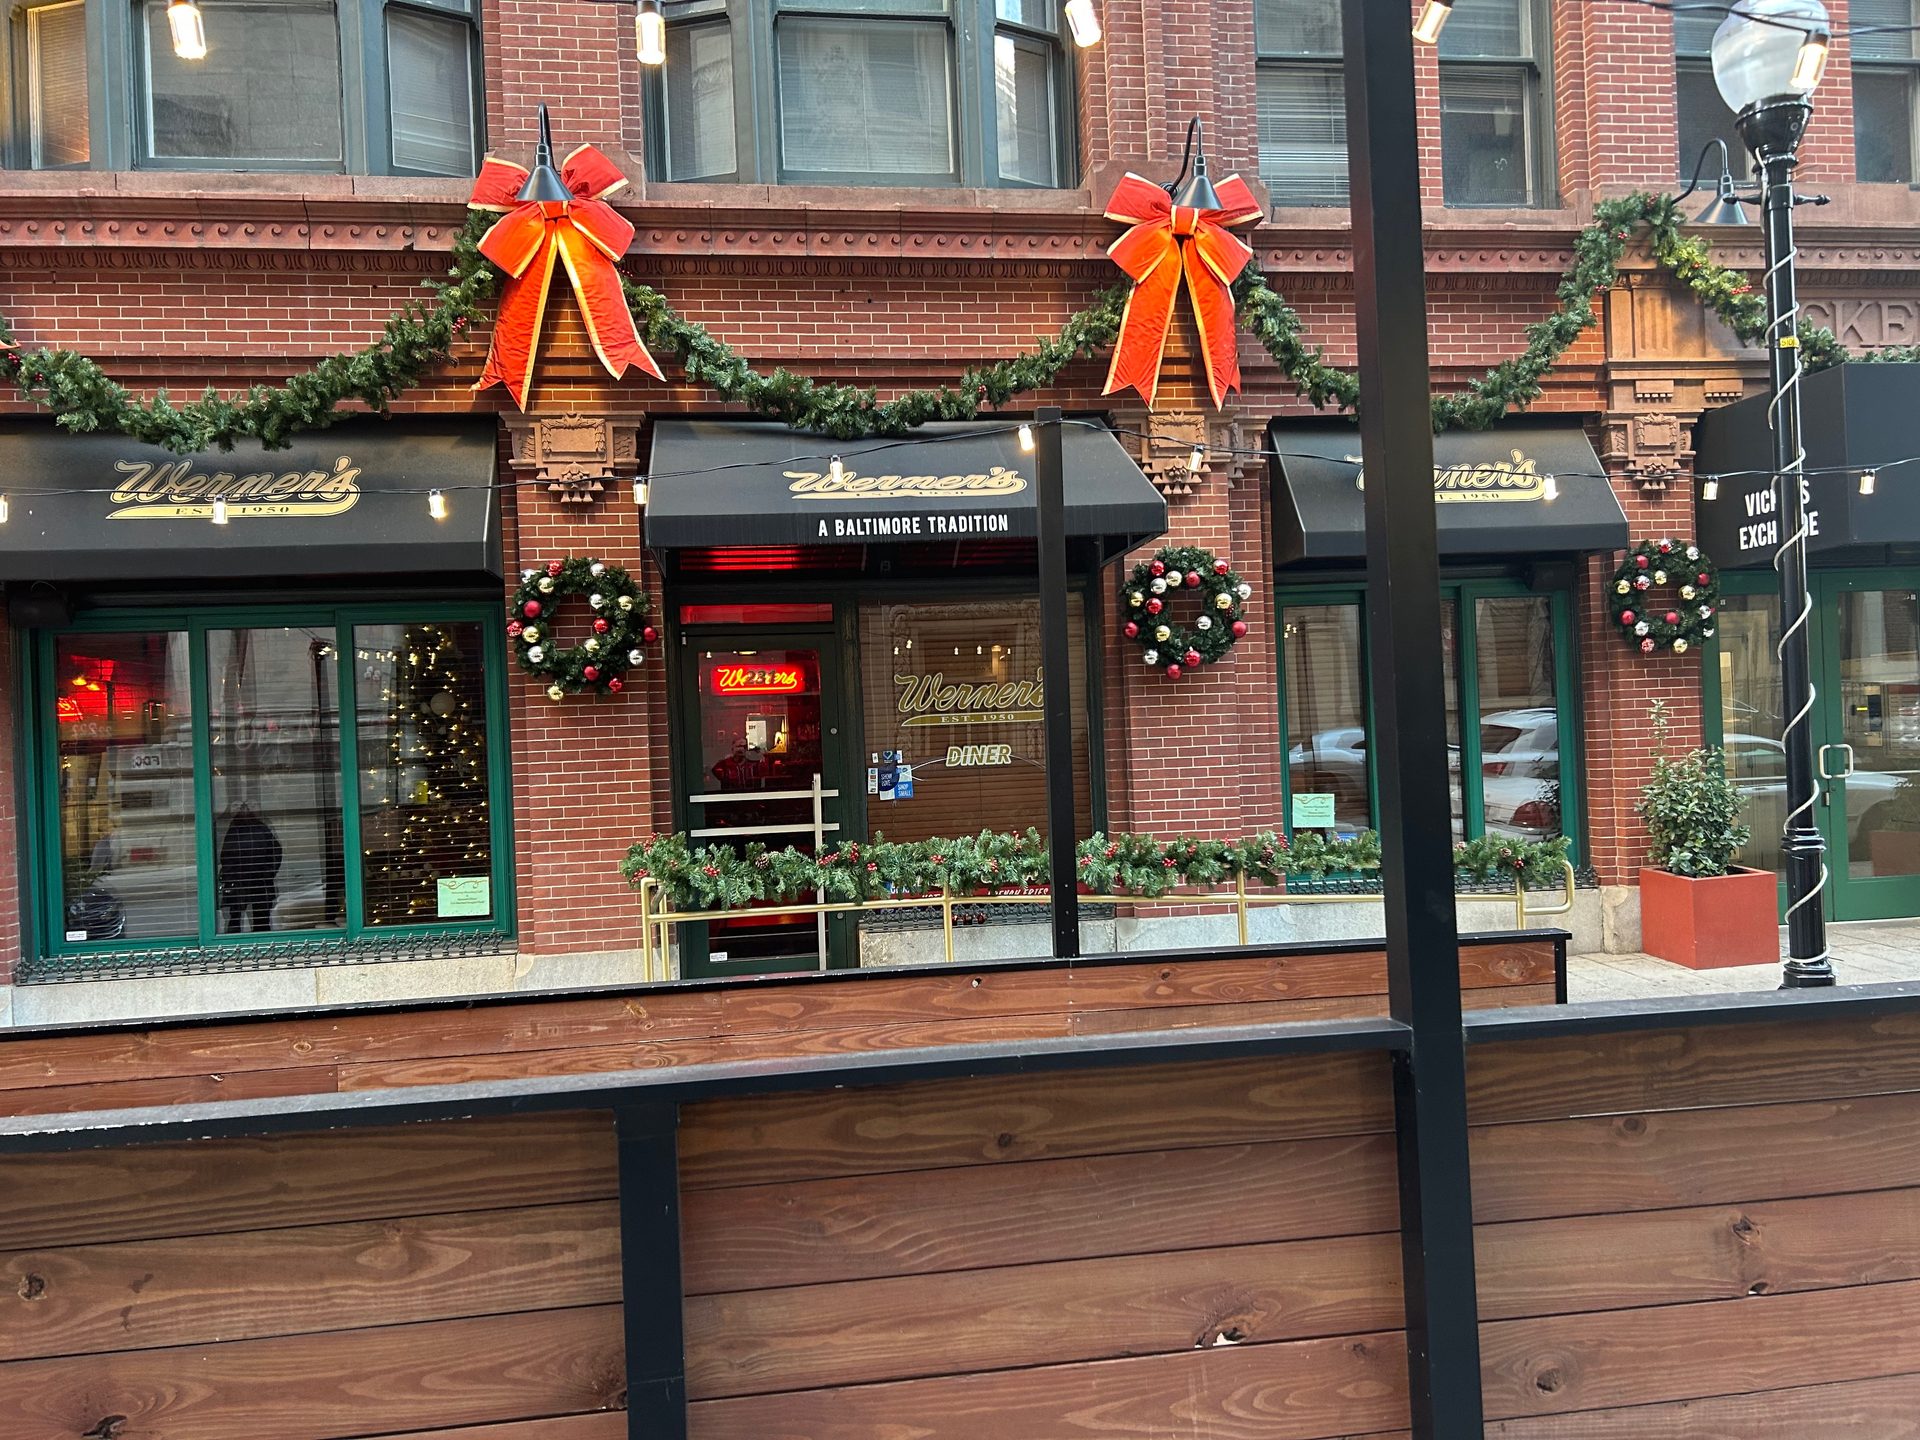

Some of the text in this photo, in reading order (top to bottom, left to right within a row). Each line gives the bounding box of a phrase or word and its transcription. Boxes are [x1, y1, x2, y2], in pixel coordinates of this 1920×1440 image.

[1796, 300, 1920, 347] CKE
[110, 456, 362, 503] Werner's
[783, 466, 1020, 492] Werner's
[242, 506, 289, 514] 1950
[1744, 479, 1811, 517] VICS
[818, 514, 1009, 537] A BALTIMORE TRADITION
[1739, 510, 1820, 550] EXCHE
[717, 668, 798, 688] Weers
[894, 666, 1044, 713] Werner's
[941, 713, 1015, 723] EST. 1950
[946, 744, 1012, 767] DINER
